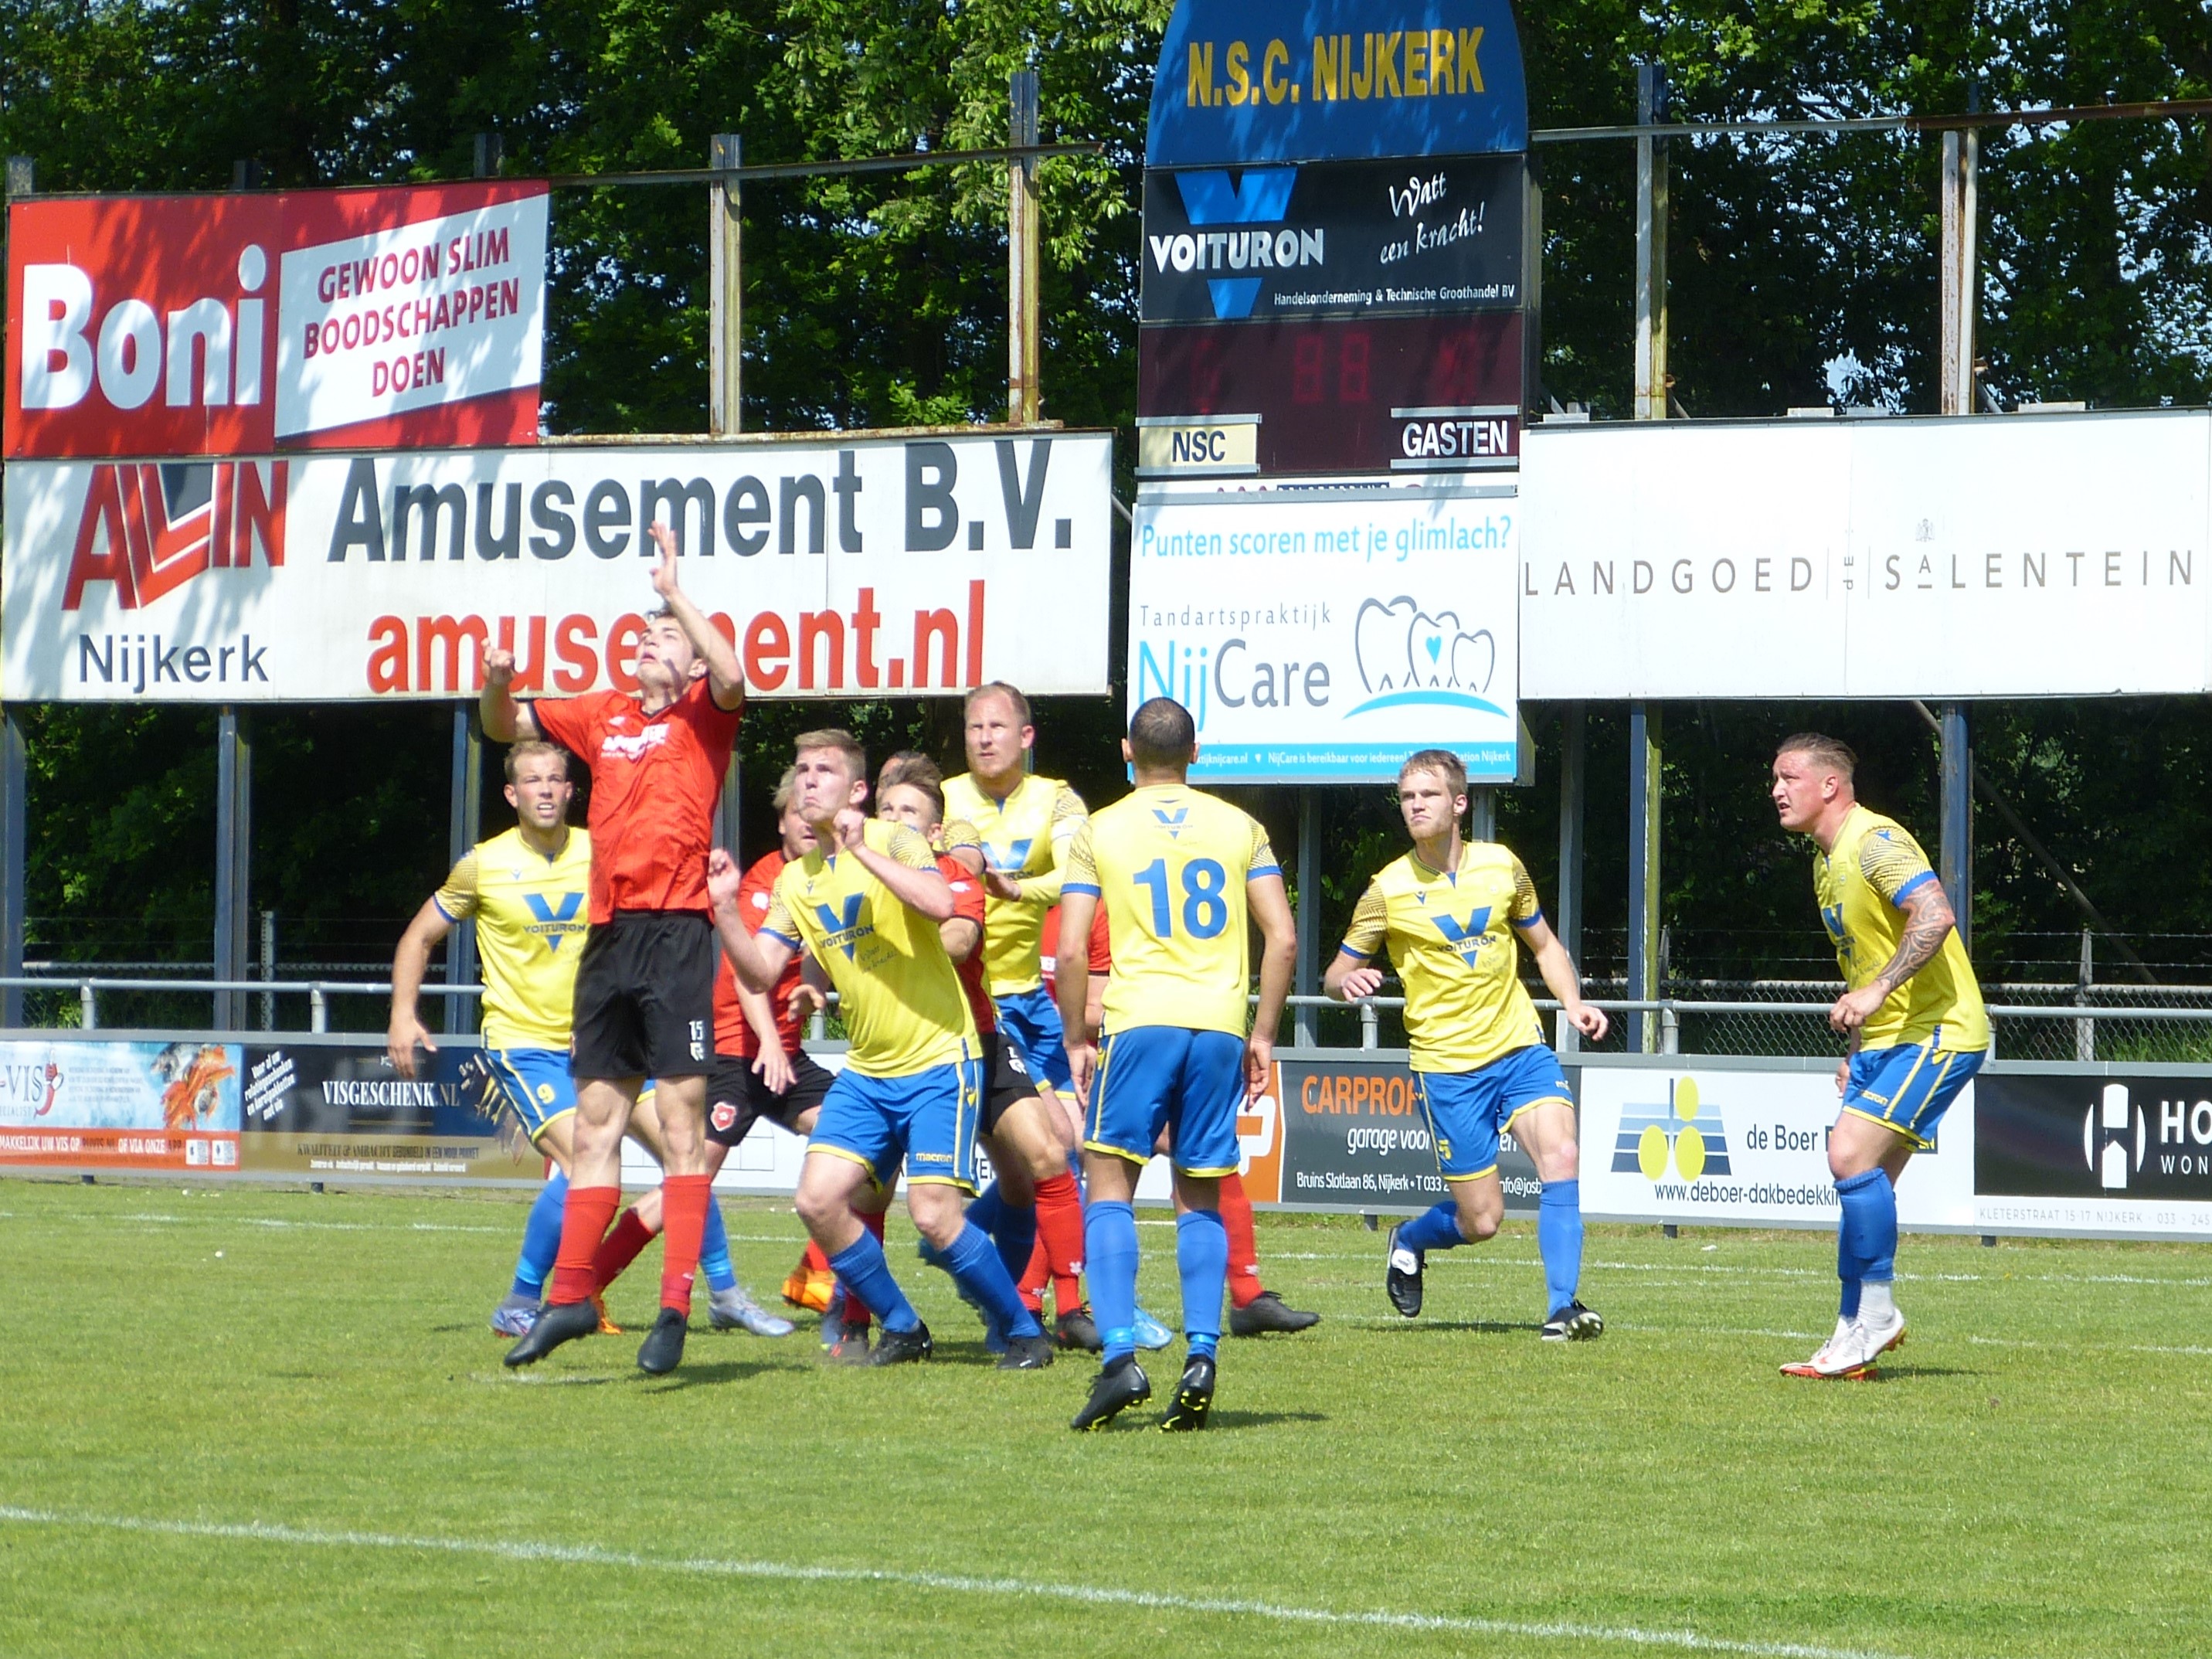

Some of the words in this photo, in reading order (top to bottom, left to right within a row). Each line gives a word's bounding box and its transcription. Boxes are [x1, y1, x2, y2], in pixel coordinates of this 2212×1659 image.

[1188, 39, 1300, 107] N.S.C.
[1313, 27, 1484, 101] NIJKERK
[1388, 172, 1447, 218] Watt
[1380, 235, 1409, 265] een
[1415, 202, 1486, 255] kracht!
[318, 243, 439, 304] GEWOON
[447, 227, 510, 276] SLIM
[1149, 229, 1323, 274] VOITURON
[1274, 289, 1372, 305] Handelsonderneming
[1375, 290, 1383, 301] &
[1386, 287, 1436, 301] Technische
[1439, 284, 1499, 299] Groothandel
[1502, 284, 1515, 298] BV
[20, 244, 267, 410] Boni
[303, 277, 519, 360] BOODSCHAPPEN
[372, 348, 445, 397] DOEN
[1171, 430, 1225, 462] NSC
[1402, 420, 1507, 457] GASTEN
[328, 450, 862, 562] Amusement
[905, 440, 1071, 552] B.V.
[1141, 525, 1222, 557] Punten
[1229, 526, 1305, 556] scoren
[1314, 525, 1360, 552] met
[1367, 523, 1387, 563] je
[1395, 515, 1511, 562] glimlach?
[1525, 556, 1813, 597] LANDGOED
[1885, 549, 2193, 590] SALENTEIN
[1140, 602, 1330, 631] Tandartspraktijk
[367, 580, 984, 694] amuseent.nl
[79, 634, 269, 694] Nijkerk
[1139, 639, 1330, 731] NijCare
[1268, 752, 1297, 767] NijCare
[1299, 753, 1305, 763] is
[1306, 752, 1348, 763] bereikbaar
[1350, 754, 1368, 763] voor
[1481, 750, 1510, 764] Nijkerk
[1133, 858, 1228, 939] 18
[522, 923, 586, 933] VOITURON
[821, 924, 874, 949] VOITURON
[1437, 935, 1496, 951] VOITURON
[688, 1020, 703, 1041] 15
[322, 1079, 460, 1107] VISGESCHENK.NL
[56, 1137, 68, 1151] VIS
[130, 1138, 144, 1154] VIA
[145, 1139, 165, 1154] ONZE
[297, 1144, 340, 1156] KWALITEIT
[1347, 1127, 1398, 1156] garage
[1746, 1124, 1768, 1150] de
[1775, 1125, 1819, 1151] Boer
[916, 1152, 953, 1163] macron
[2160, 1154, 2208, 1175] WON
[1296, 1171, 1324, 1188] Bruins
[1326, 1171, 1361, 1190] Slotlaan
[1362, 1174, 1377, 1192] 86,
[1378, 1173, 1409, 1194] Nijkerk
[1415, 1175, 1422, 1191] T
[1423, 1175, 1442, 1192] 033
[1979, 1208, 2060, 1222] KLETERSTRAAT
[2096, 1212, 2142, 1224] NIJKERK
[2157, 1212, 2176, 1225] 033
